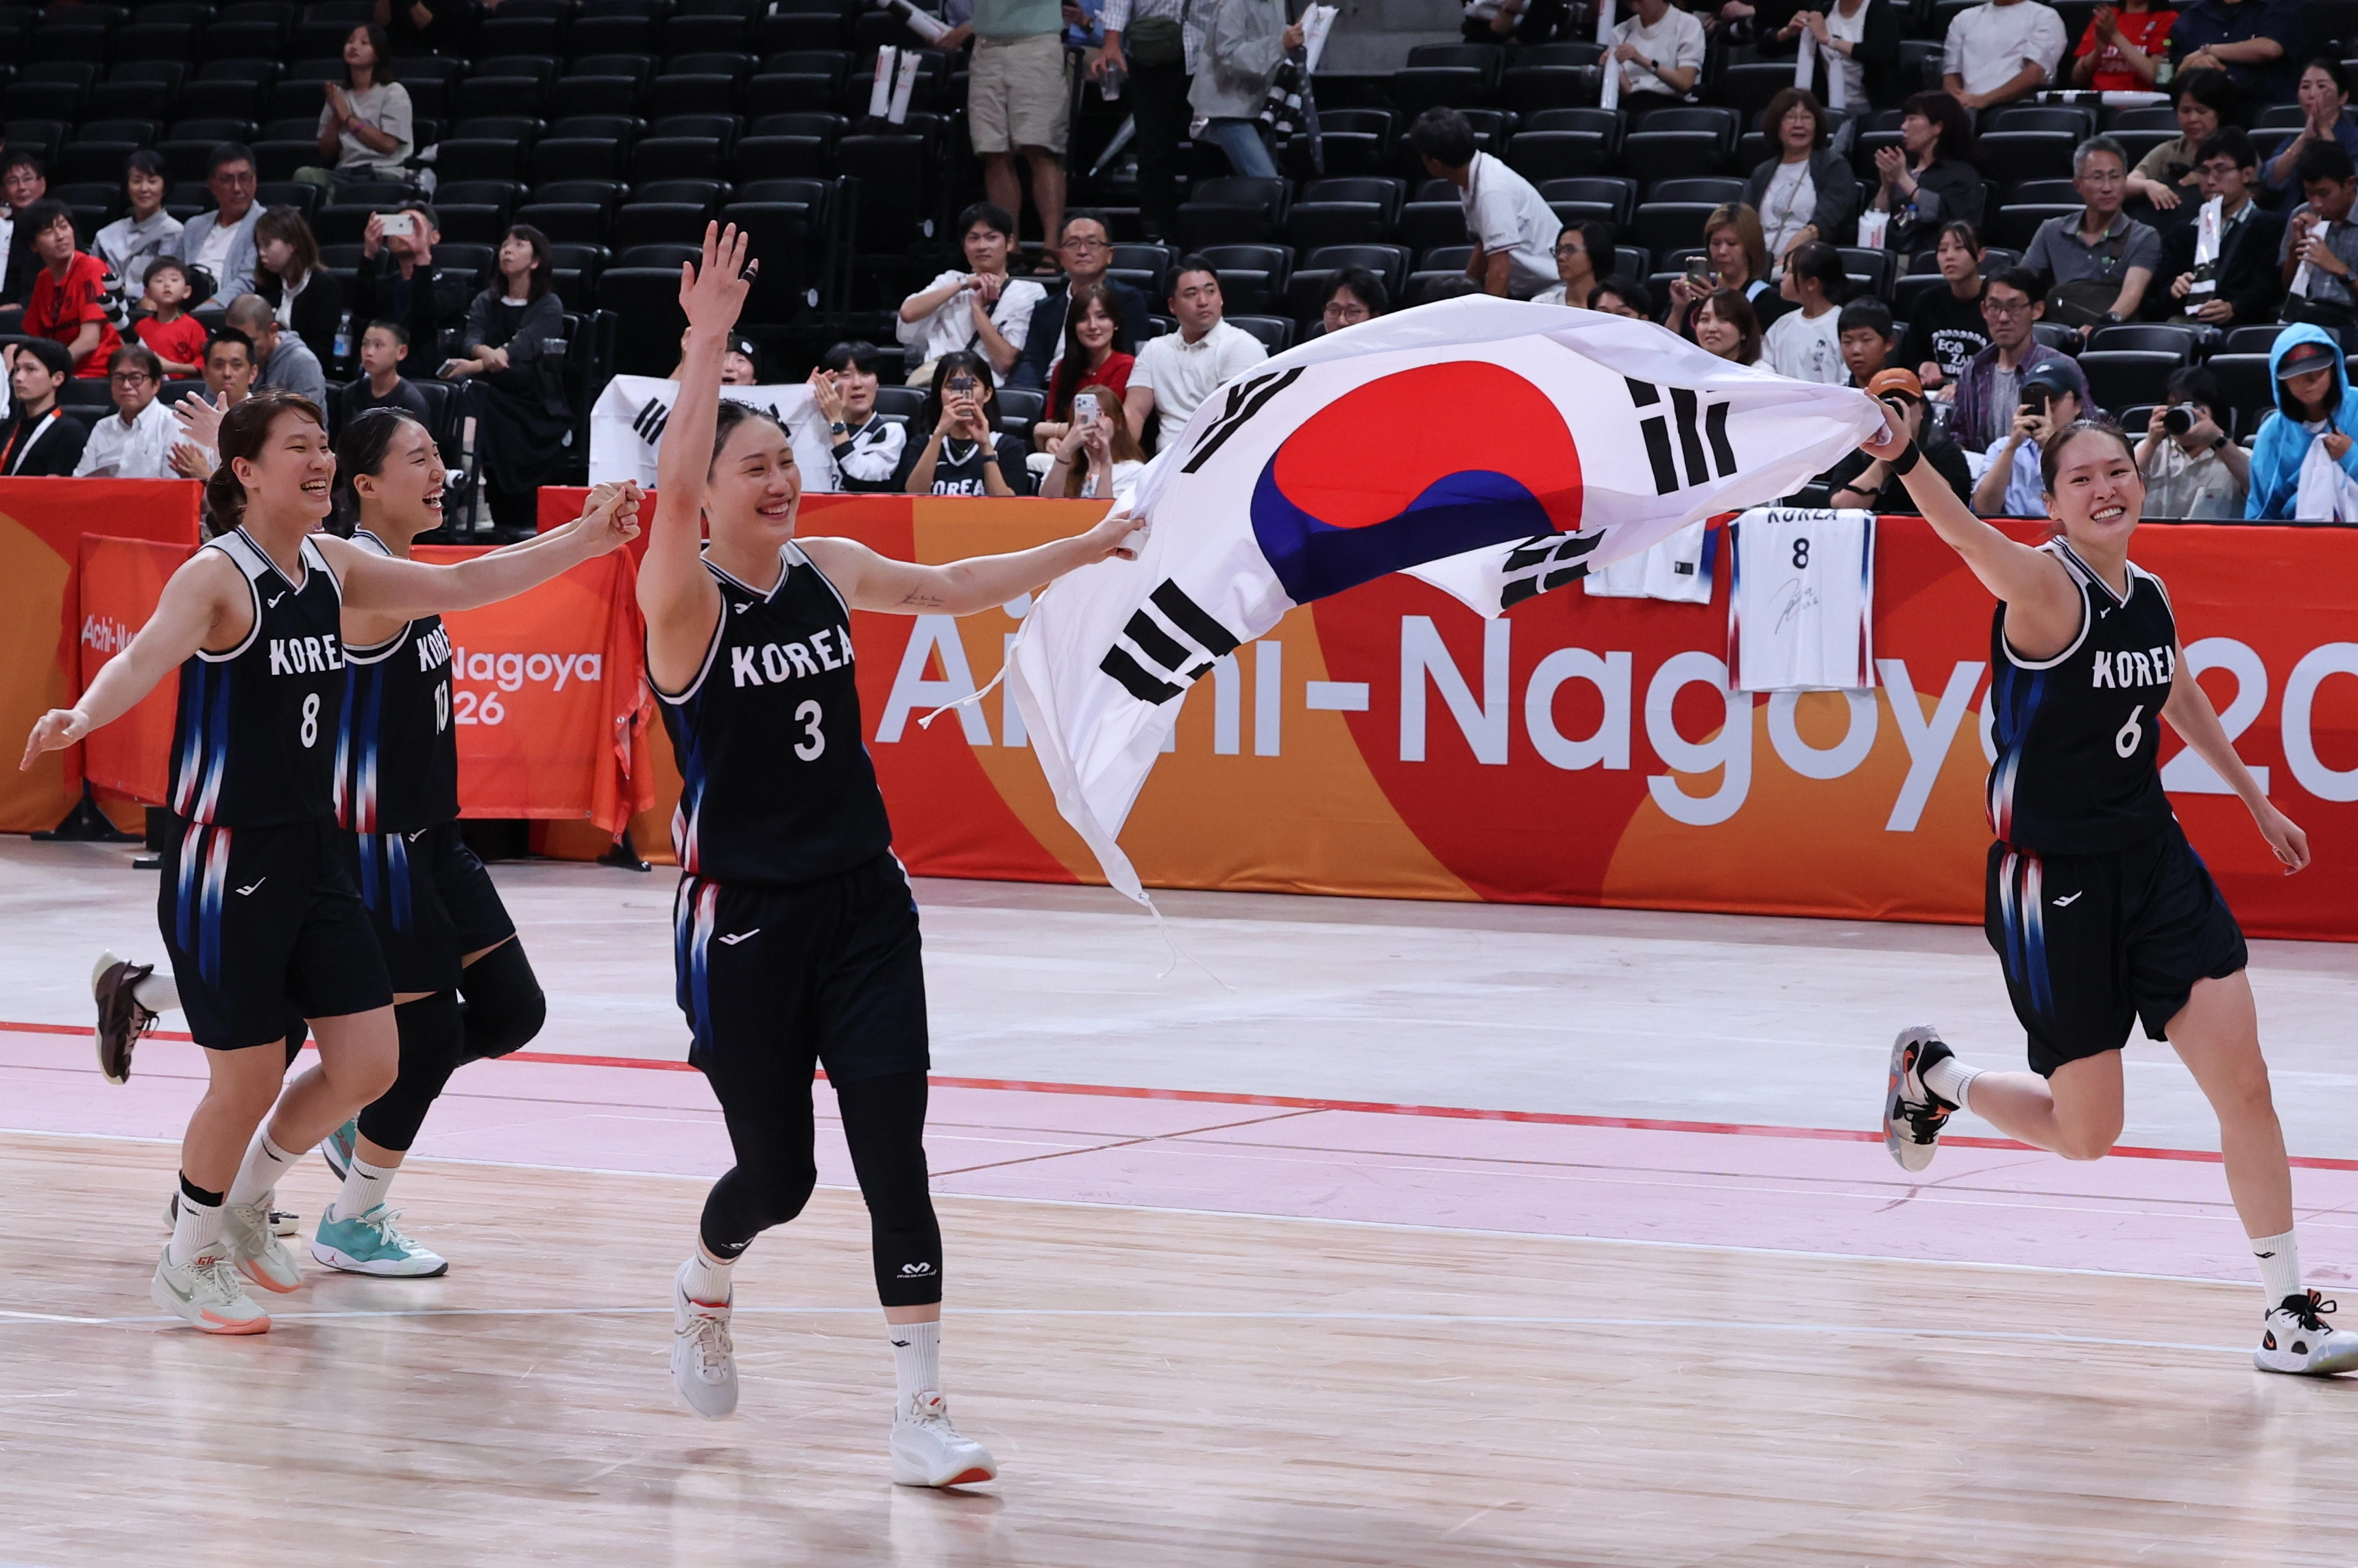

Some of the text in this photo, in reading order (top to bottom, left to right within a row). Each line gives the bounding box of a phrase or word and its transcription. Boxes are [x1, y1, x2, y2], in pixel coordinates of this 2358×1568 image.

[1937, 338, 1965, 354] EGO
[931, 478, 985, 495] OREA
[1792, 537, 1810, 569] 8
[269, 633, 345, 675] KORE
[731, 624, 855, 687] KOREA
[2092, 645, 2175, 689] KOREA
[300, 693, 320, 748] 8
[434, 679, 449, 735] 10
[794, 699, 825, 761] 3
[2115, 705, 2144, 759] 6
